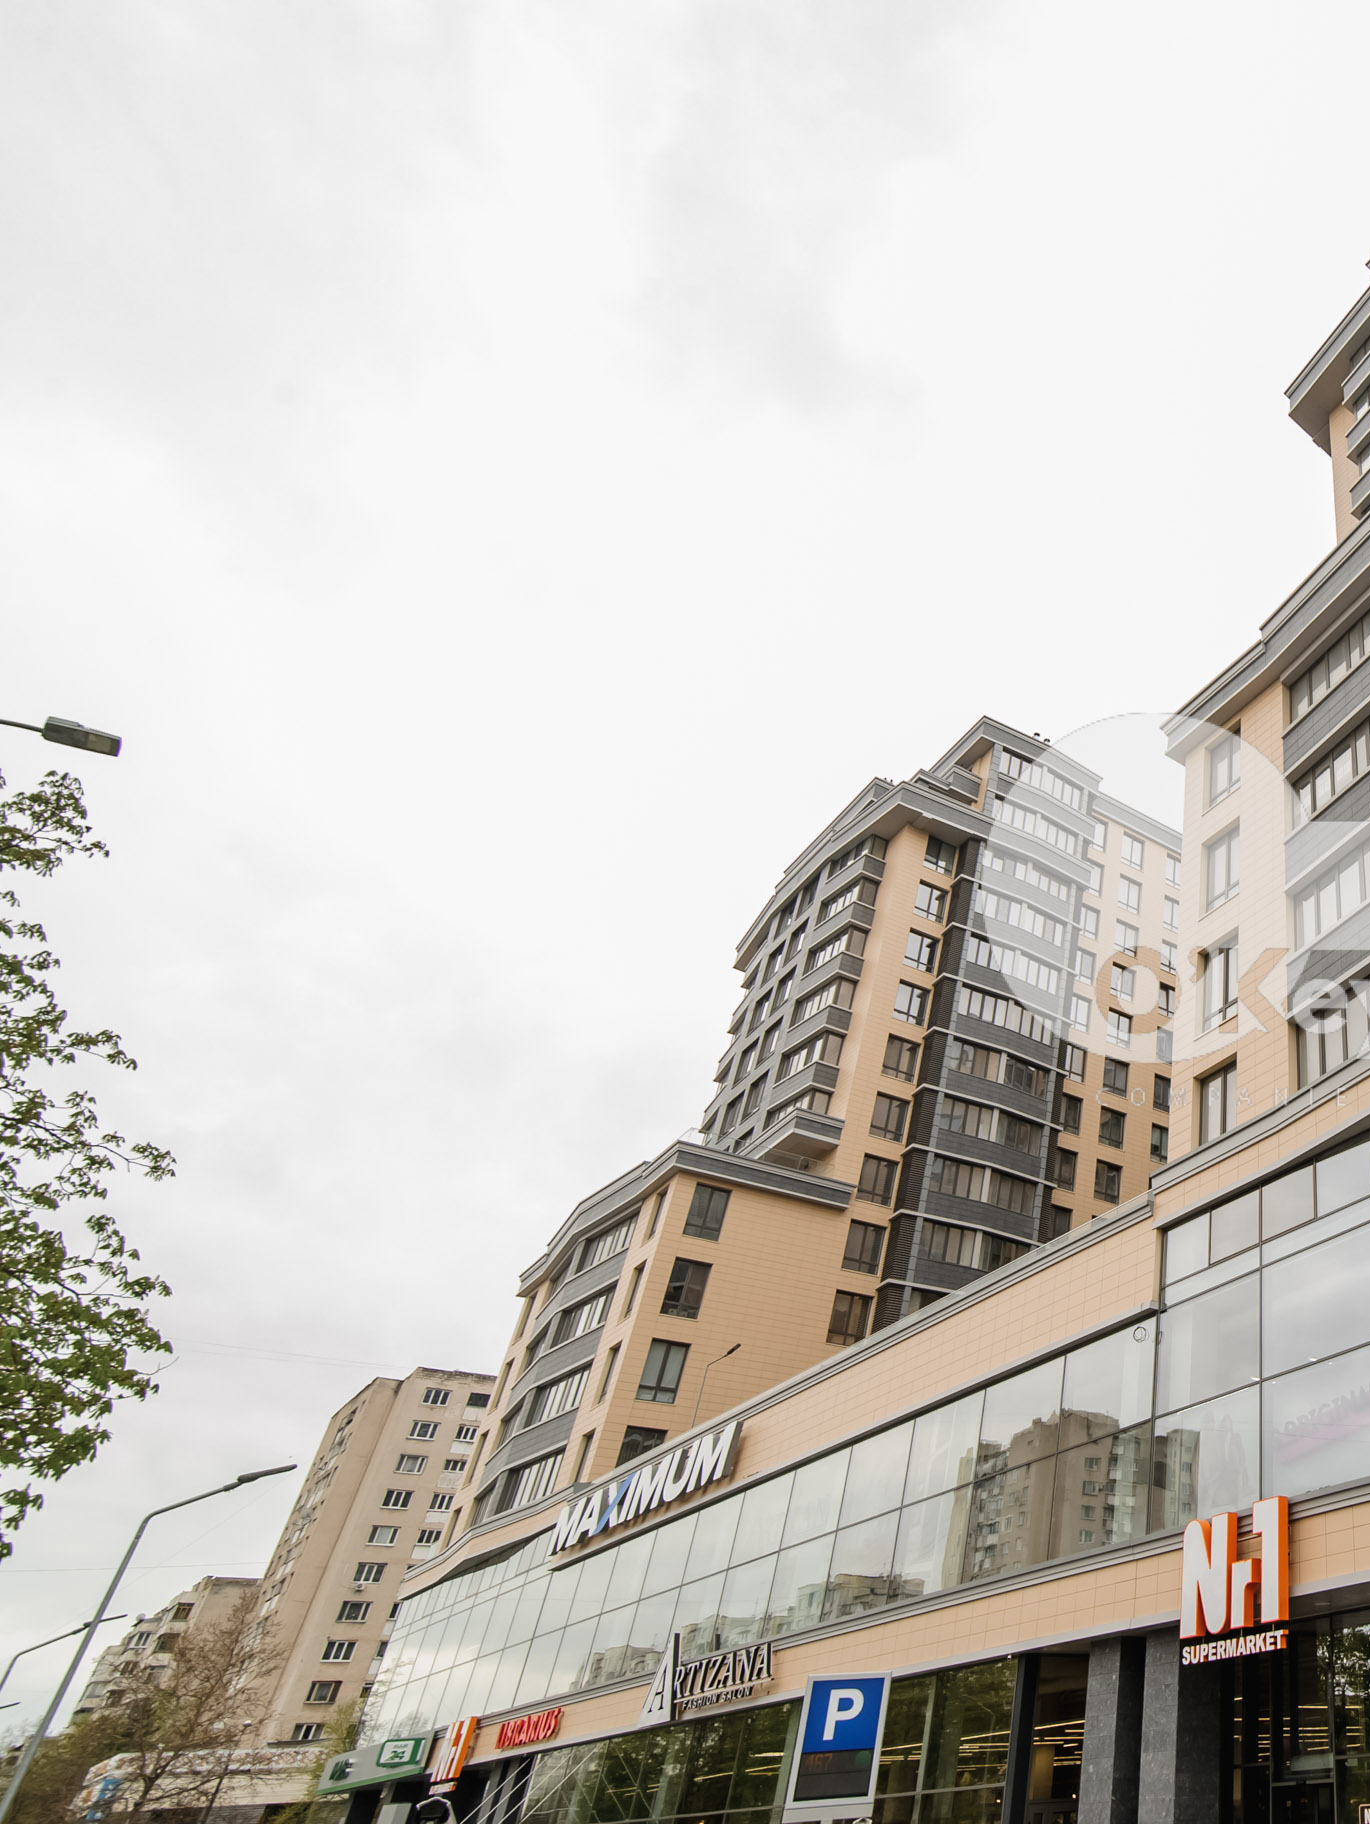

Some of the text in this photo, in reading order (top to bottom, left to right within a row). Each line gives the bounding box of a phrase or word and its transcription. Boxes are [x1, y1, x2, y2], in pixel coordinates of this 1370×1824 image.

[548, 1420, 742, 1557] MAXIMUM
[1182, 1629, 1288, 1666] SUPERMARKET
[681, 1686, 753, 1711] FASHION SALON
[822, 1687, 865, 1741] P
